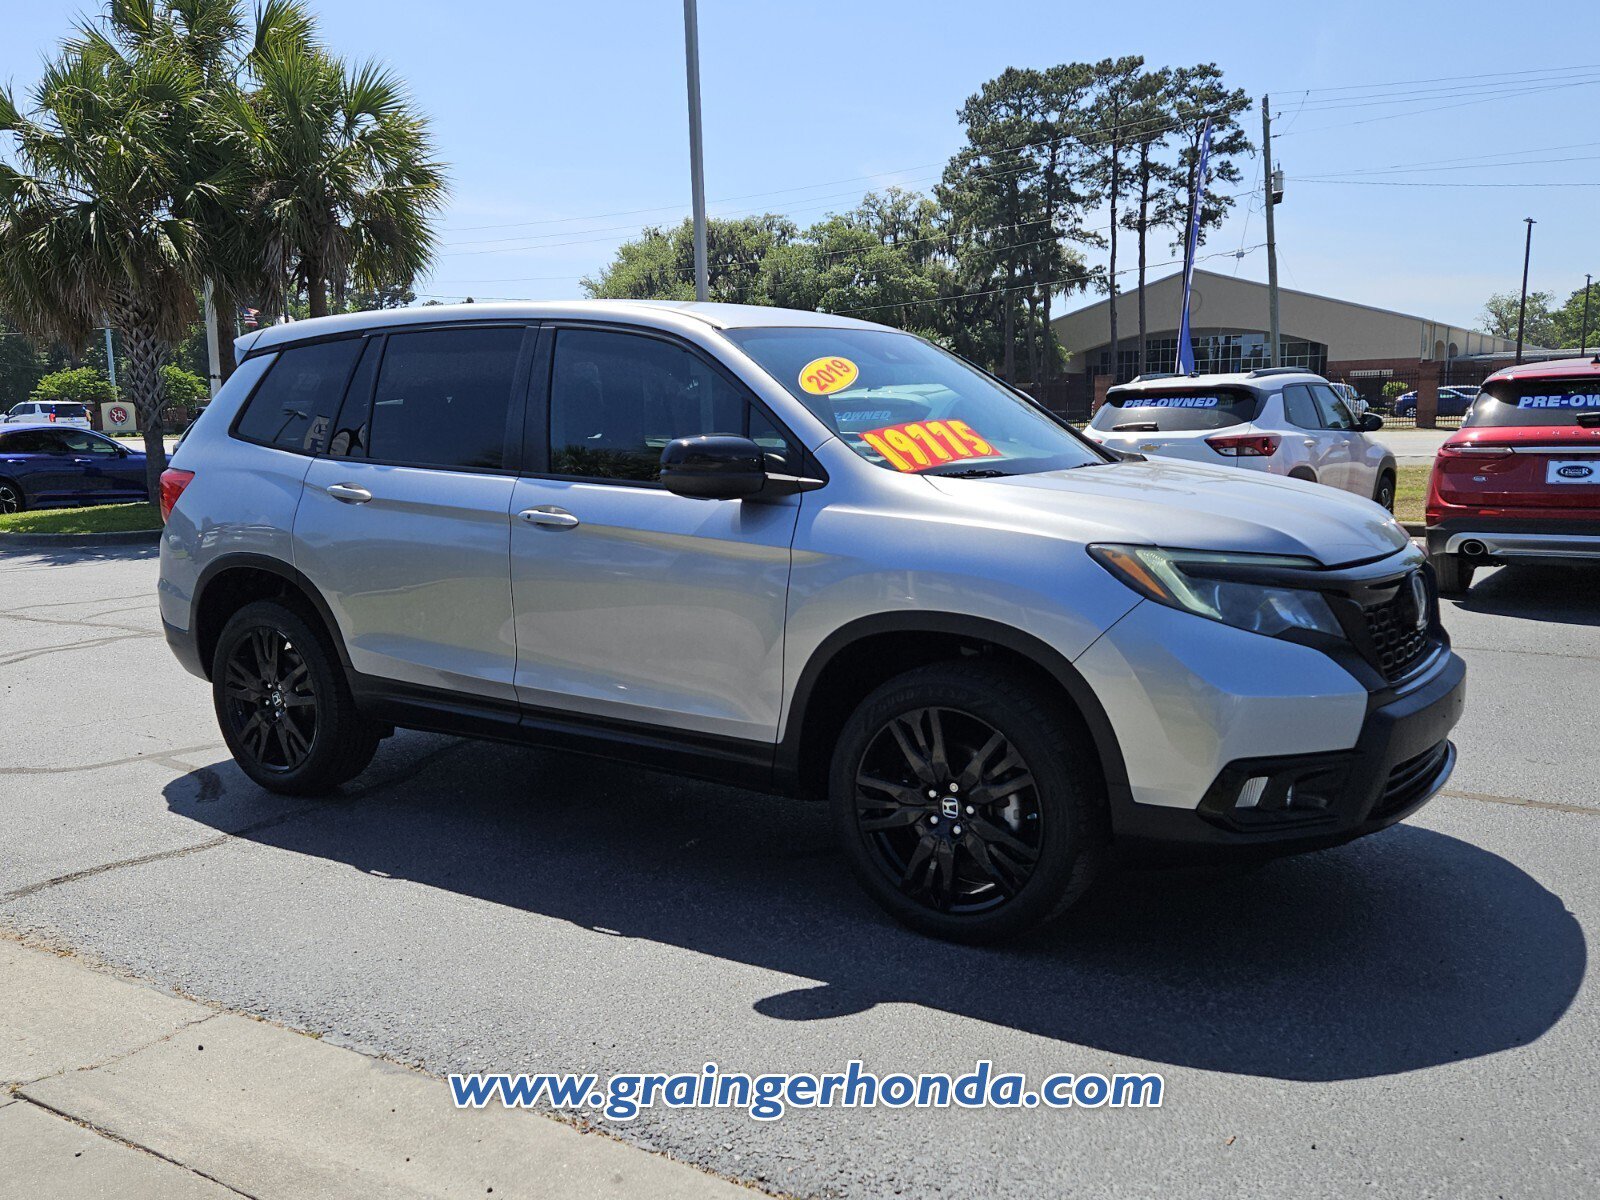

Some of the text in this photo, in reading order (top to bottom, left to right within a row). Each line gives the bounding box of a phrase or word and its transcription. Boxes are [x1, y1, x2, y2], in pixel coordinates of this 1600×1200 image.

[807, 360, 850, 391] 2019
[1122, 397, 1218, 409] PRE-OWNED
[863, 420, 994, 472] 19775
